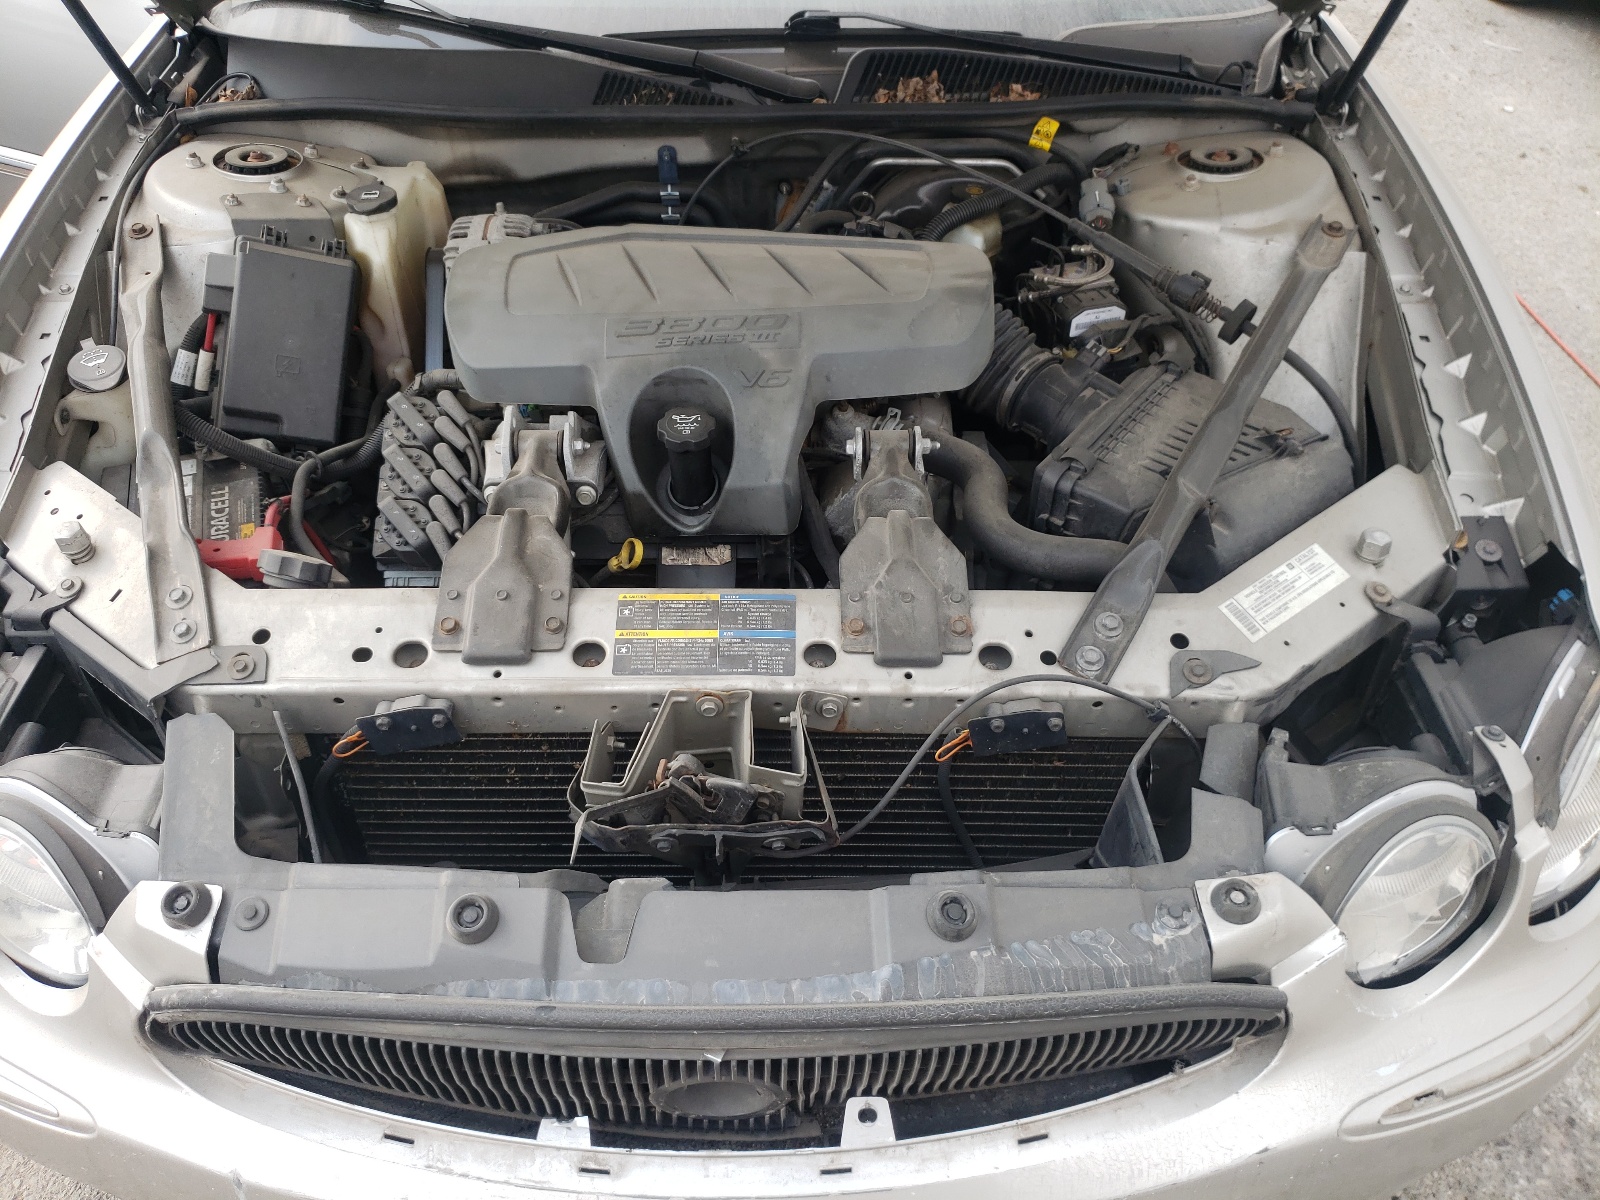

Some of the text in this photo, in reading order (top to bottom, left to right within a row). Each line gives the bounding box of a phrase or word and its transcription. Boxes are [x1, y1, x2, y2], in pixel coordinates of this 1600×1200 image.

[616, 313, 789, 338] 3800
[655, 332, 781, 348] SERIES III
[741, 368, 792, 389] V6
[210, 485, 230, 541] URACELL
[1294, 548, 1315, 563] CATALYST
